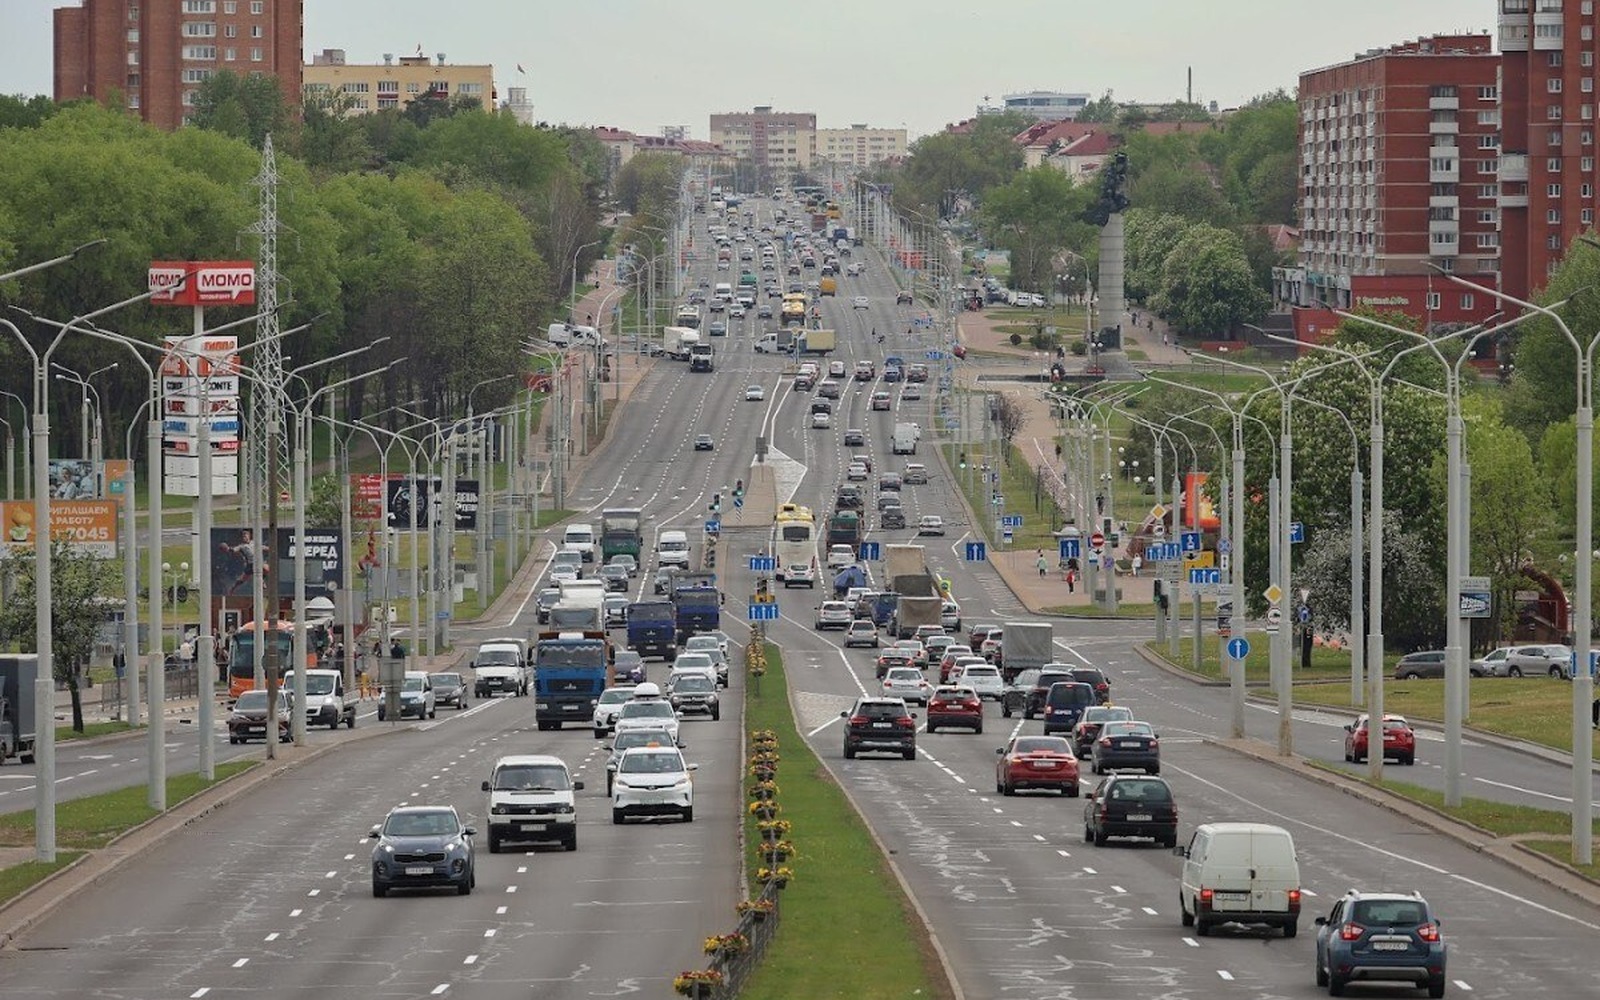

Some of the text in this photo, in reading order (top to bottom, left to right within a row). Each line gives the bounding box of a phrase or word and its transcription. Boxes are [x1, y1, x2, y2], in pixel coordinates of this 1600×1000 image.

[202, 274, 252, 287] MOMO
[56, 516, 94, 525] РАБОТУ
[289, 546, 338, 559] ВЕРЕД
